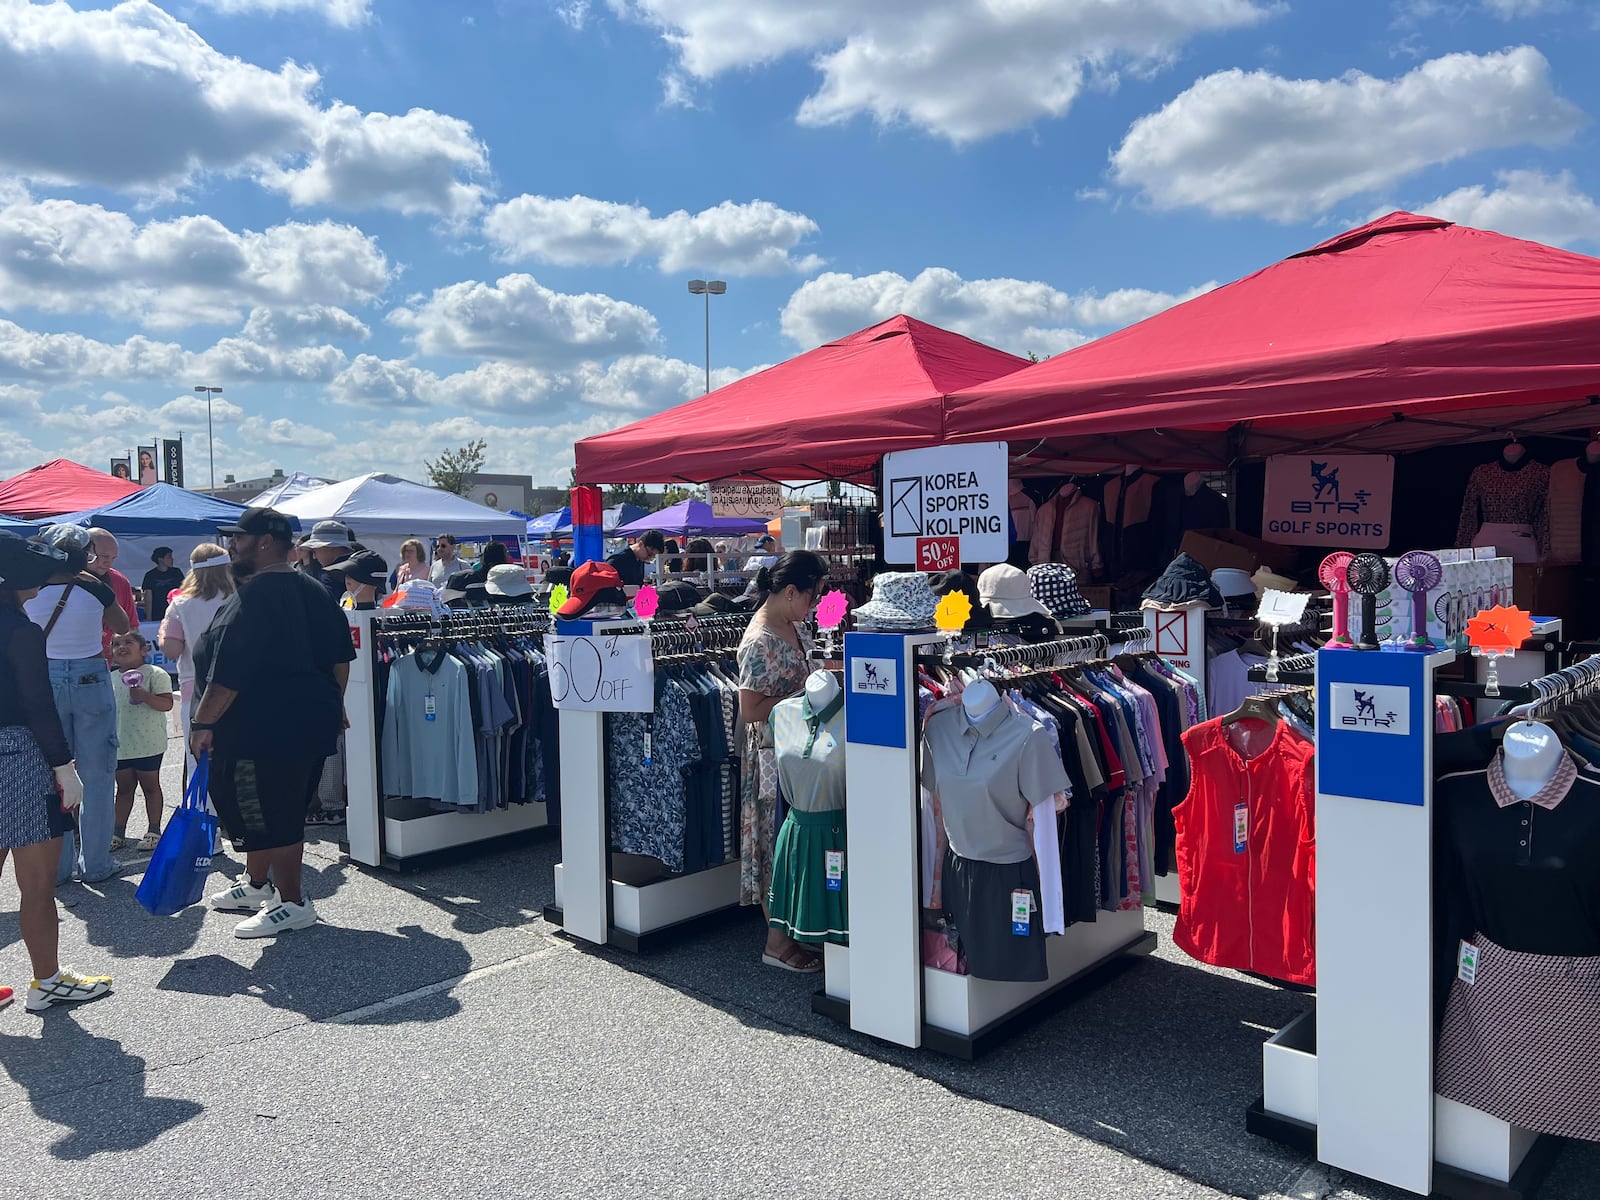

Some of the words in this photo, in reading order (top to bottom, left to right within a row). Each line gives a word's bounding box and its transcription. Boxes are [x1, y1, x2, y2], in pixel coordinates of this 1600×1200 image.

[925, 471, 979, 491] KOREA
[926, 493, 989, 513] SPORTS
[1291, 501, 1359, 514] BTR
[926, 515, 1001, 536] KOLPING
[1269, 520, 1312, 534] GOLF
[1315, 521, 1383, 537] SPORTS
[936, 555, 954, 569] OFF
[826, 604, 836, 614] M
[1272, 597, 1286, 612] L
[946, 607, 959, 617] L
[600, 678, 632, 701] OFF
[857, 682, 887, 691] BTR
[1342, 716, 1390, 728] BTR
